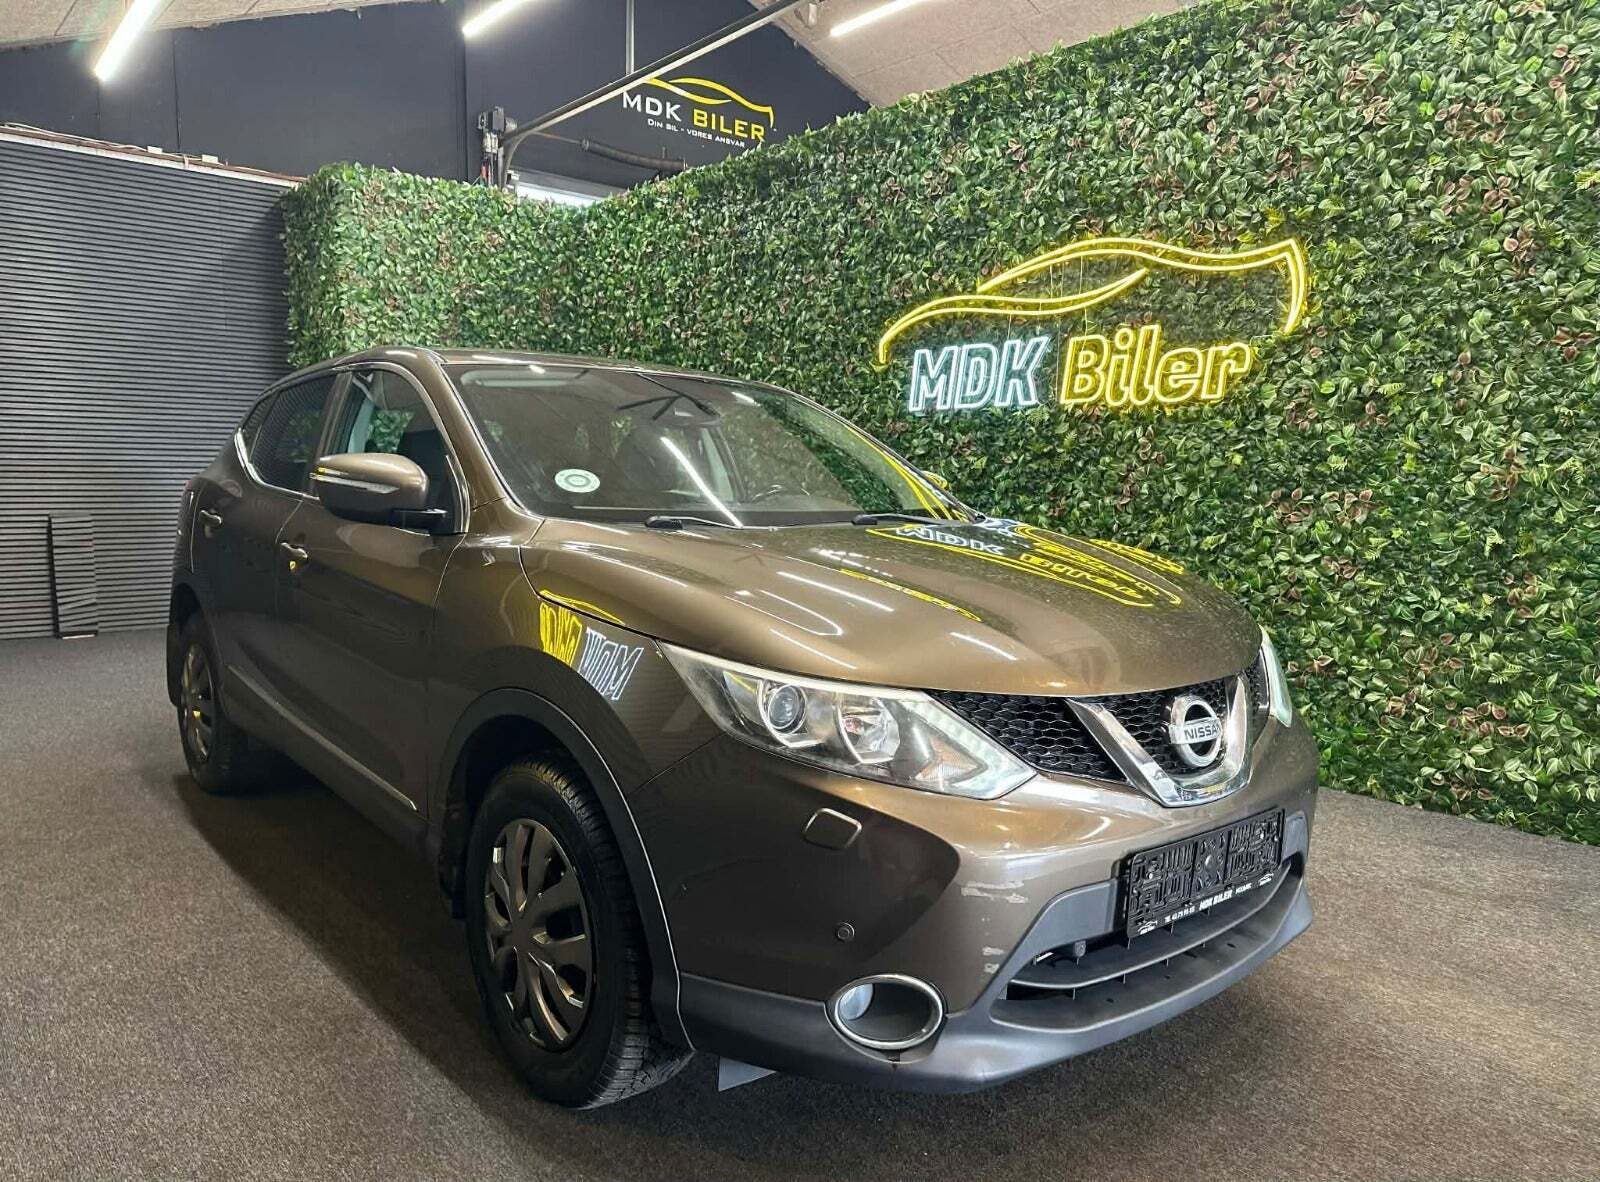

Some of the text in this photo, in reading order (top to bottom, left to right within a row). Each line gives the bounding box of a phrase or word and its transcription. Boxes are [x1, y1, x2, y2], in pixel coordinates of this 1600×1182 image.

[622, 91, 766, 142] MDK BILER
[908, 323, 1254, 412] MDK Biler
